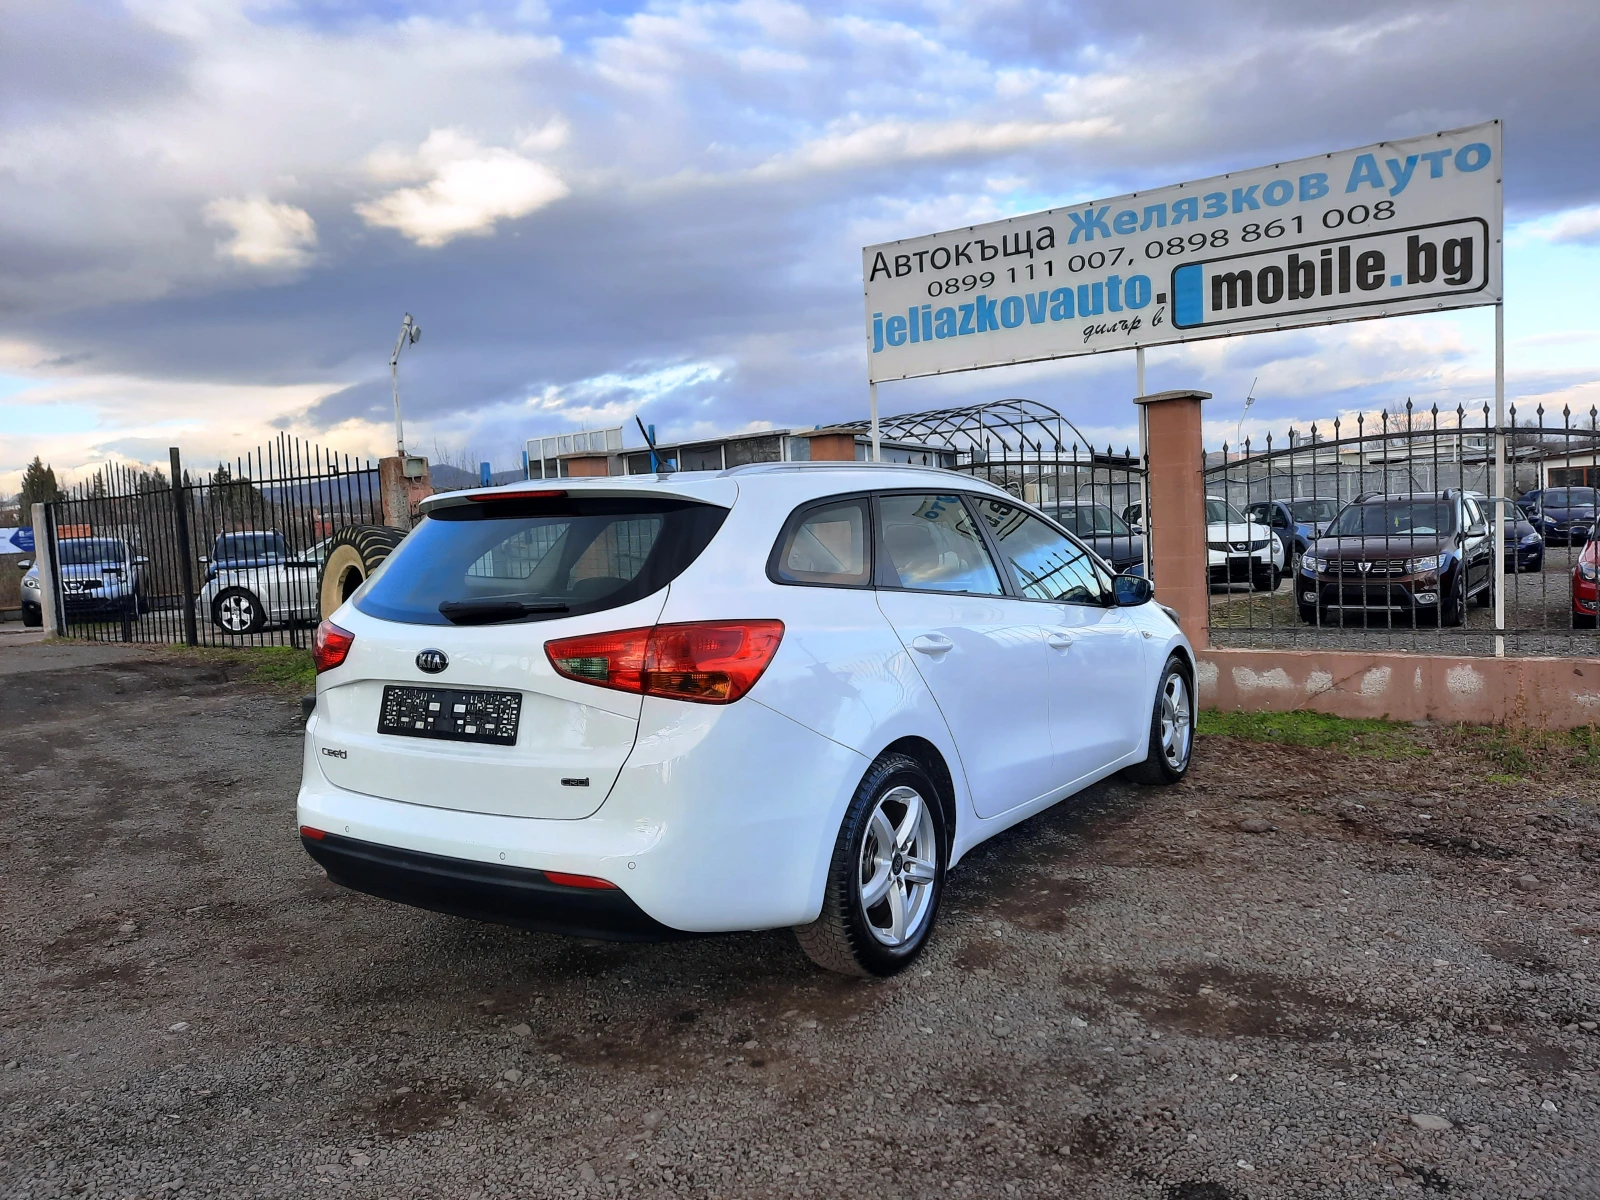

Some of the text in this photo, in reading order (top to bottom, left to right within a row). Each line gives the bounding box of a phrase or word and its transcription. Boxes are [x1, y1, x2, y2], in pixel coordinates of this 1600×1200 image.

[869, 142, 1492, 282] Автокъща Желязков Ауто
[927, 200, 1396, 298] 0899 111 007, 0898 861 008
[1211, 234, 1474, 312] mobile.bg
[1082, 314, 1143, 343] дилър
